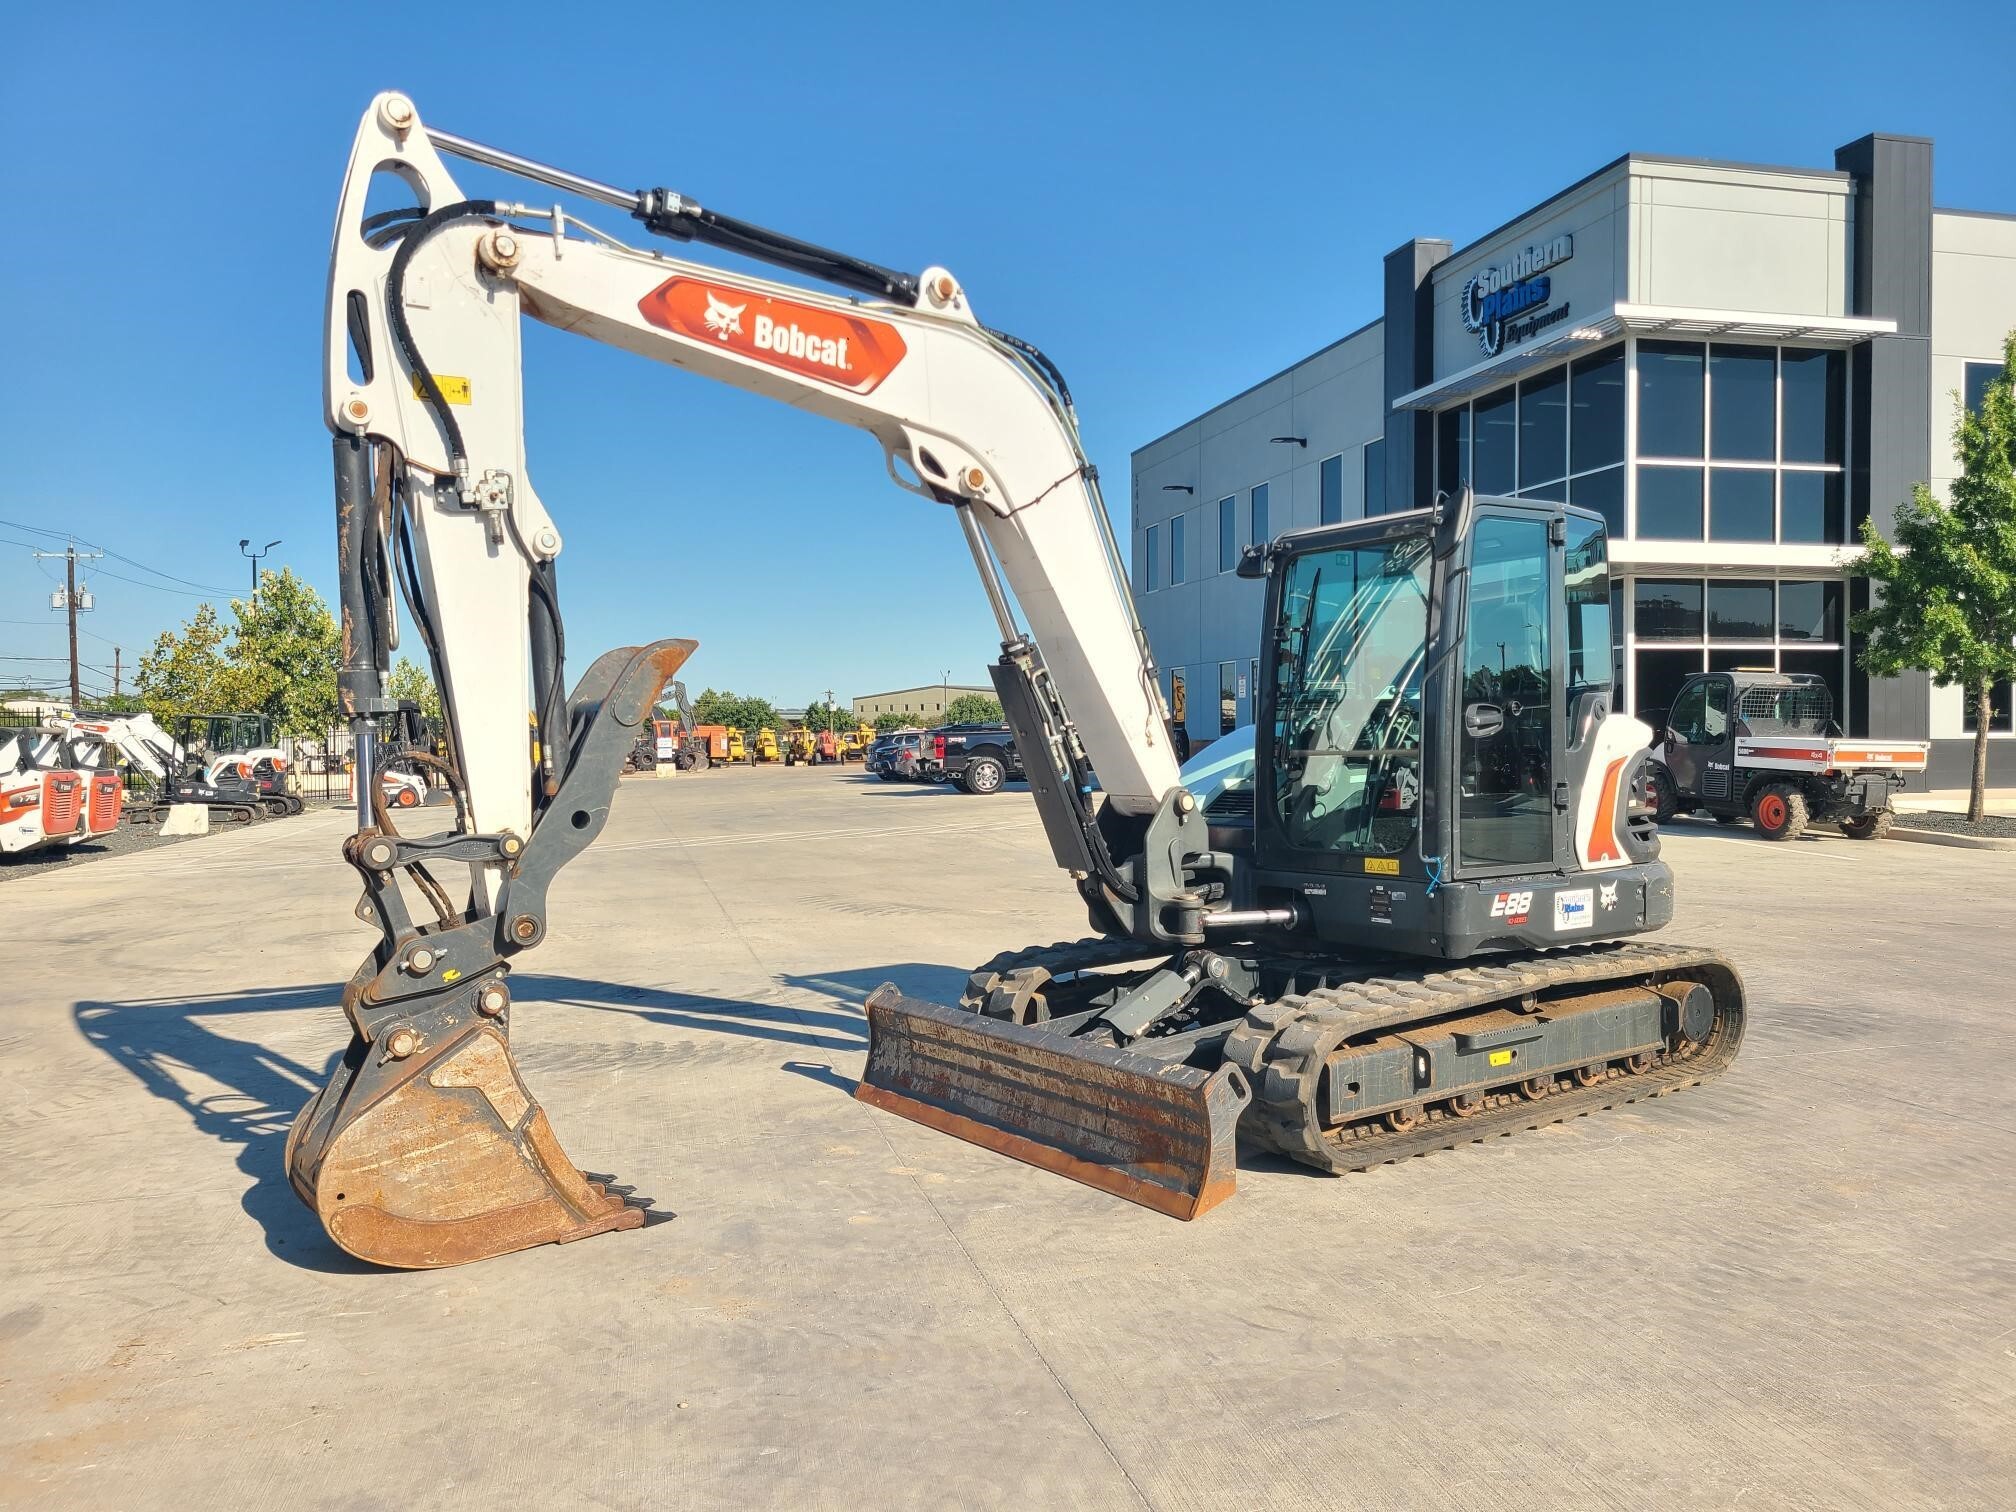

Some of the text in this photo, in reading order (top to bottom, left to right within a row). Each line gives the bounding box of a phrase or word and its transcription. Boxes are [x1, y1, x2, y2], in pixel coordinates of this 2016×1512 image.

[1477, 234, 1573, 298] Southern
[1482, 277, 1550, 324] Plains
[1505, 302, 1570, 343] Equipment
[754, 314, 849, 370] Bobcat
[1714, 762, 1730, 771] Bobcat
[1490, 891, 1533, 917] E88
